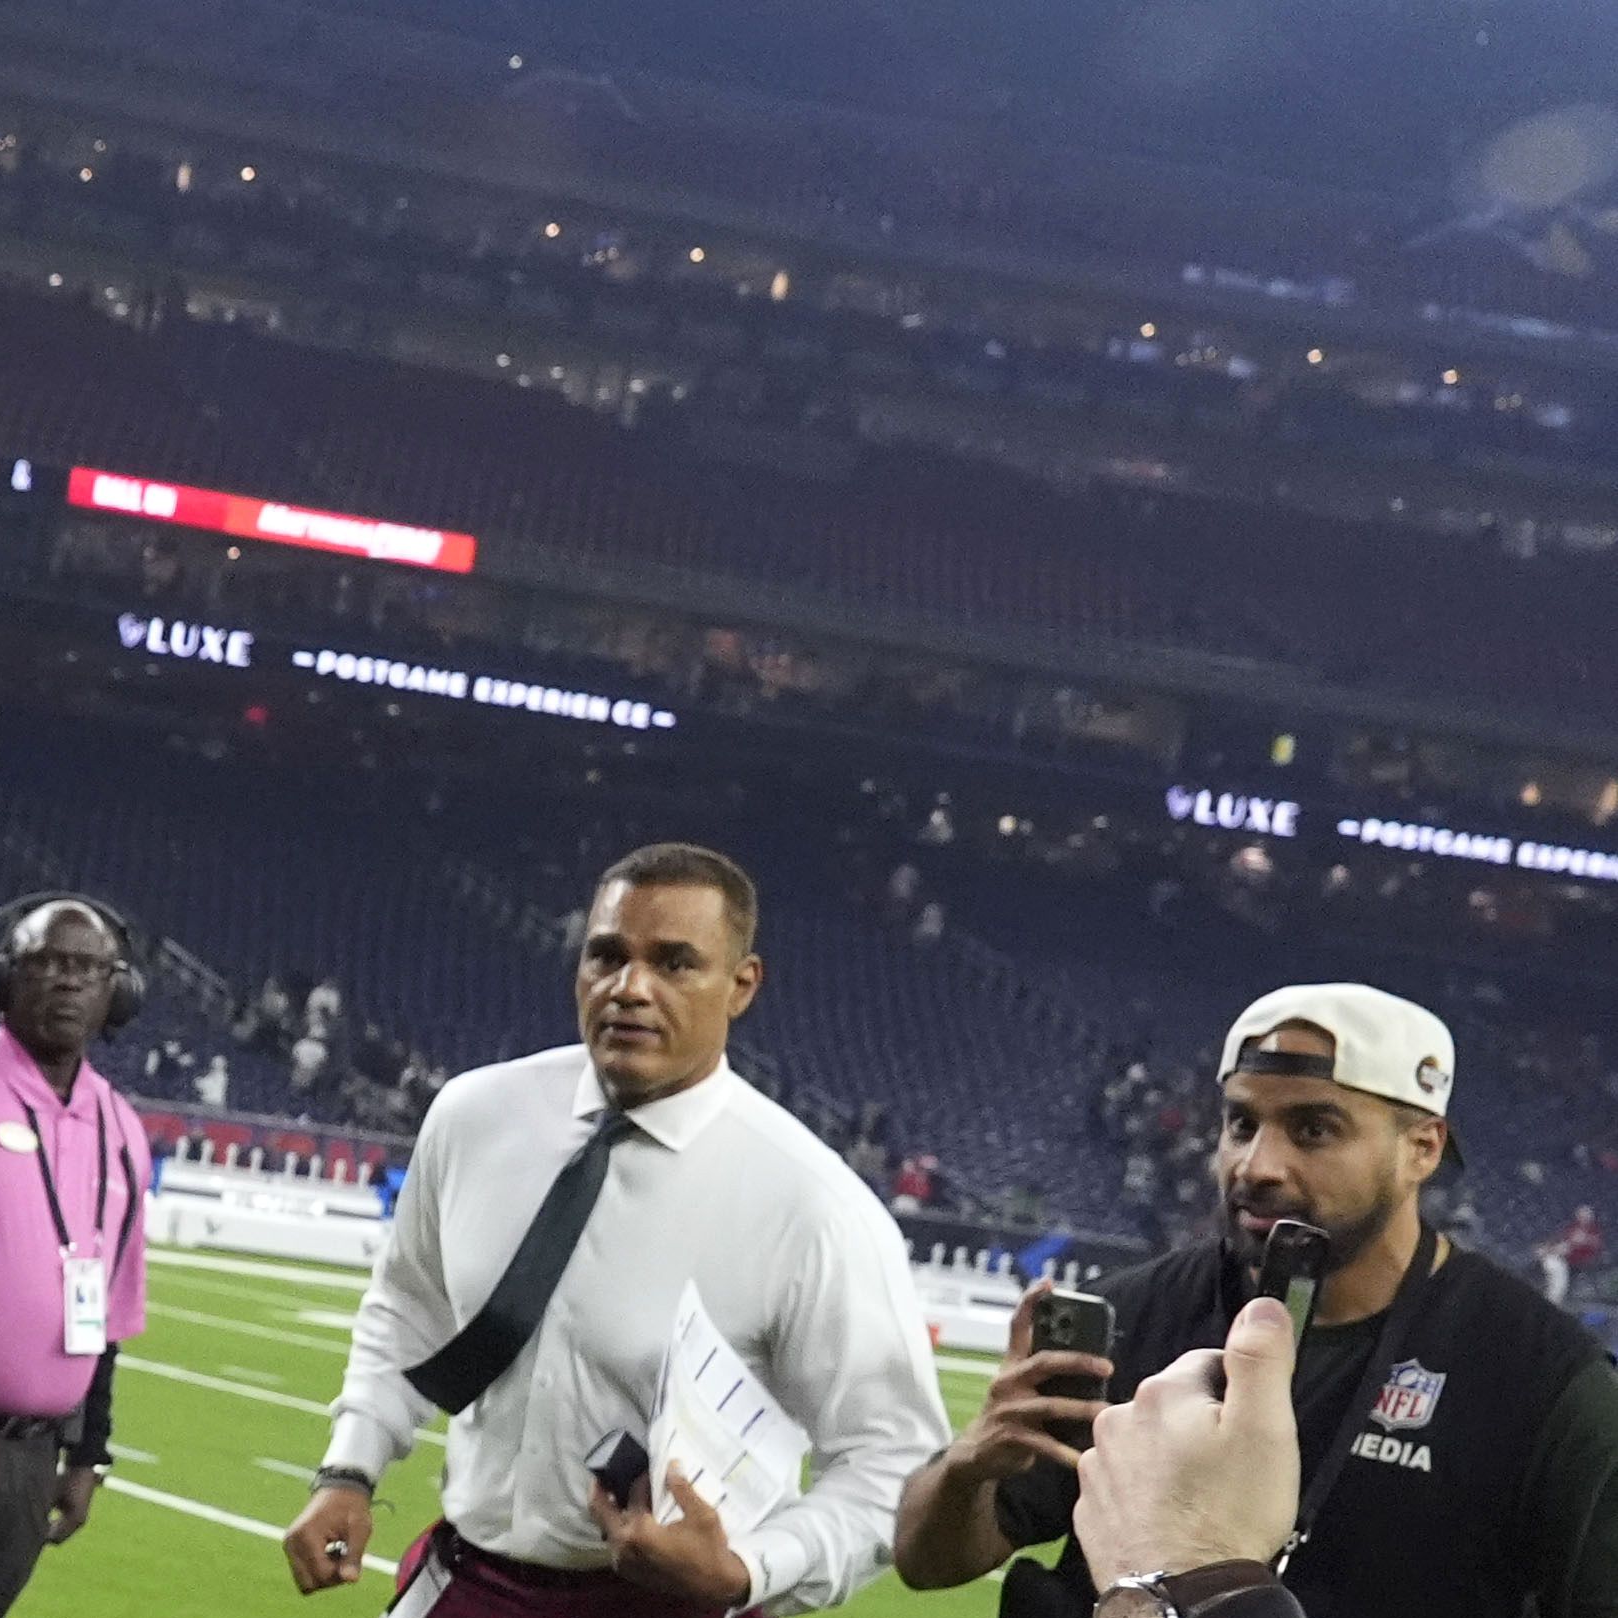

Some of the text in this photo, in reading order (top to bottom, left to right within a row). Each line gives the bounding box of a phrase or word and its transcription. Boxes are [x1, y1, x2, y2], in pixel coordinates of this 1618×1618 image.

[146, 616, 255, 668] LUXE
[1193, 788, 1301, 838] LUXE
[1372, 1387, 1423, 1420] NFL
